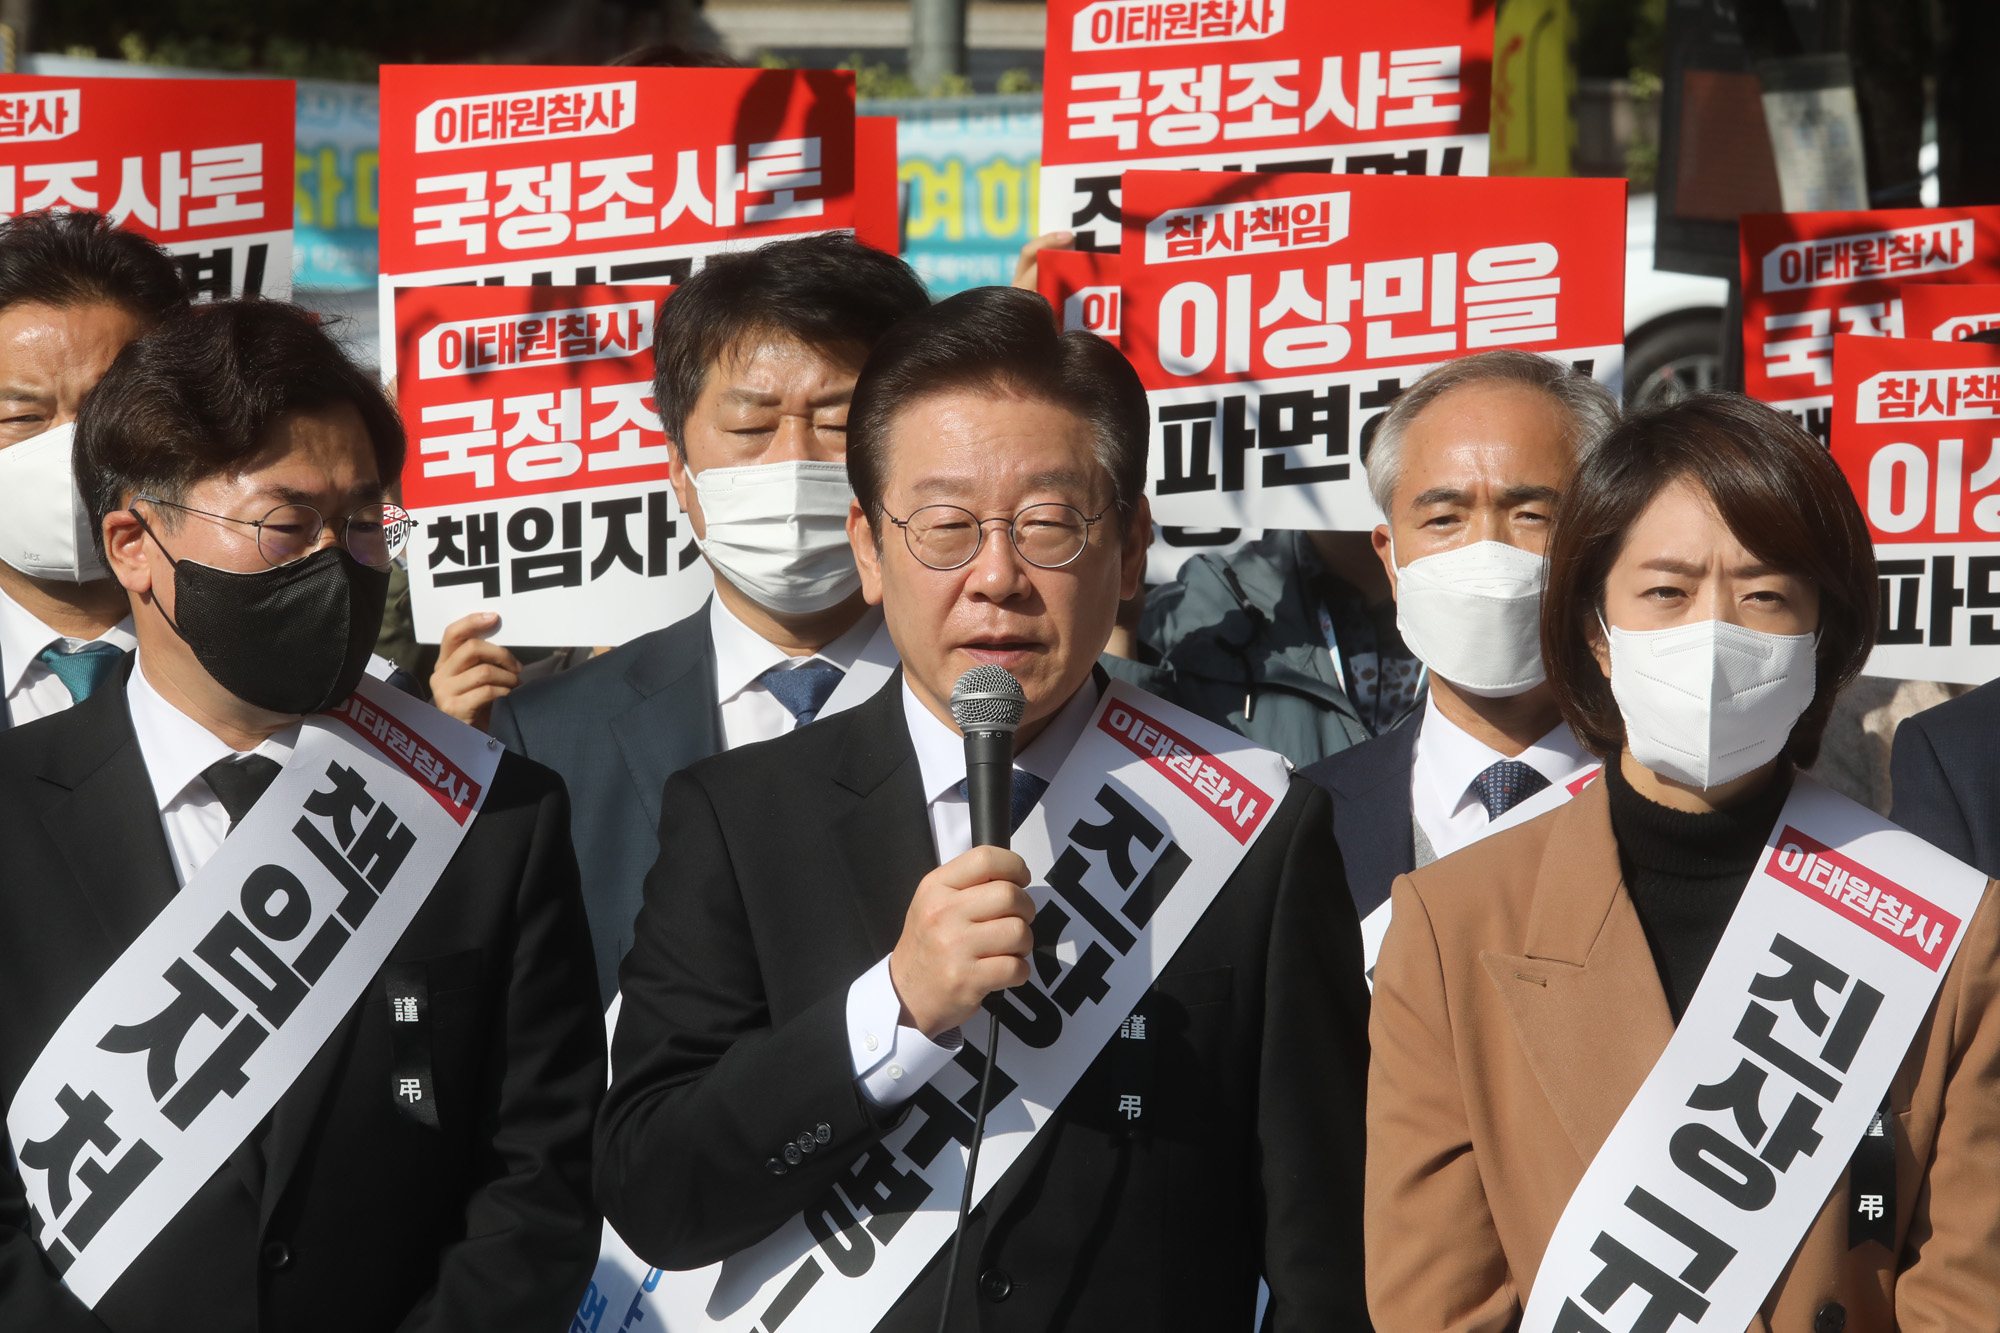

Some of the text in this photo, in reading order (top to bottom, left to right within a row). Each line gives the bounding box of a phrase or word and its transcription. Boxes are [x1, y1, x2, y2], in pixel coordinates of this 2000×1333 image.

[1091, 0, 1274, 44] 이태원참사
[434, 89, 625, 144] 이태원참사
[1068, 46, 1461, 150] 국정조사로
[0, 142, 264, 232] 조사로
[413, 136, 824, 255] 국정조사로
[1165, 200, 1331, 259] 참사책임
[1780, 227, 1963, 285] 이태원참사
[438, 310, 643, 371] 이태원참사
[1158, 242, 1561, 376] 이상민을
[1110, 706, 1258, 828] 이태원참사
[1777, 843, 1944, 956] 이태원참사
[19, 759, 418, 1280] 책임자처
[1551, 933, 1885, 1333] 진상규
